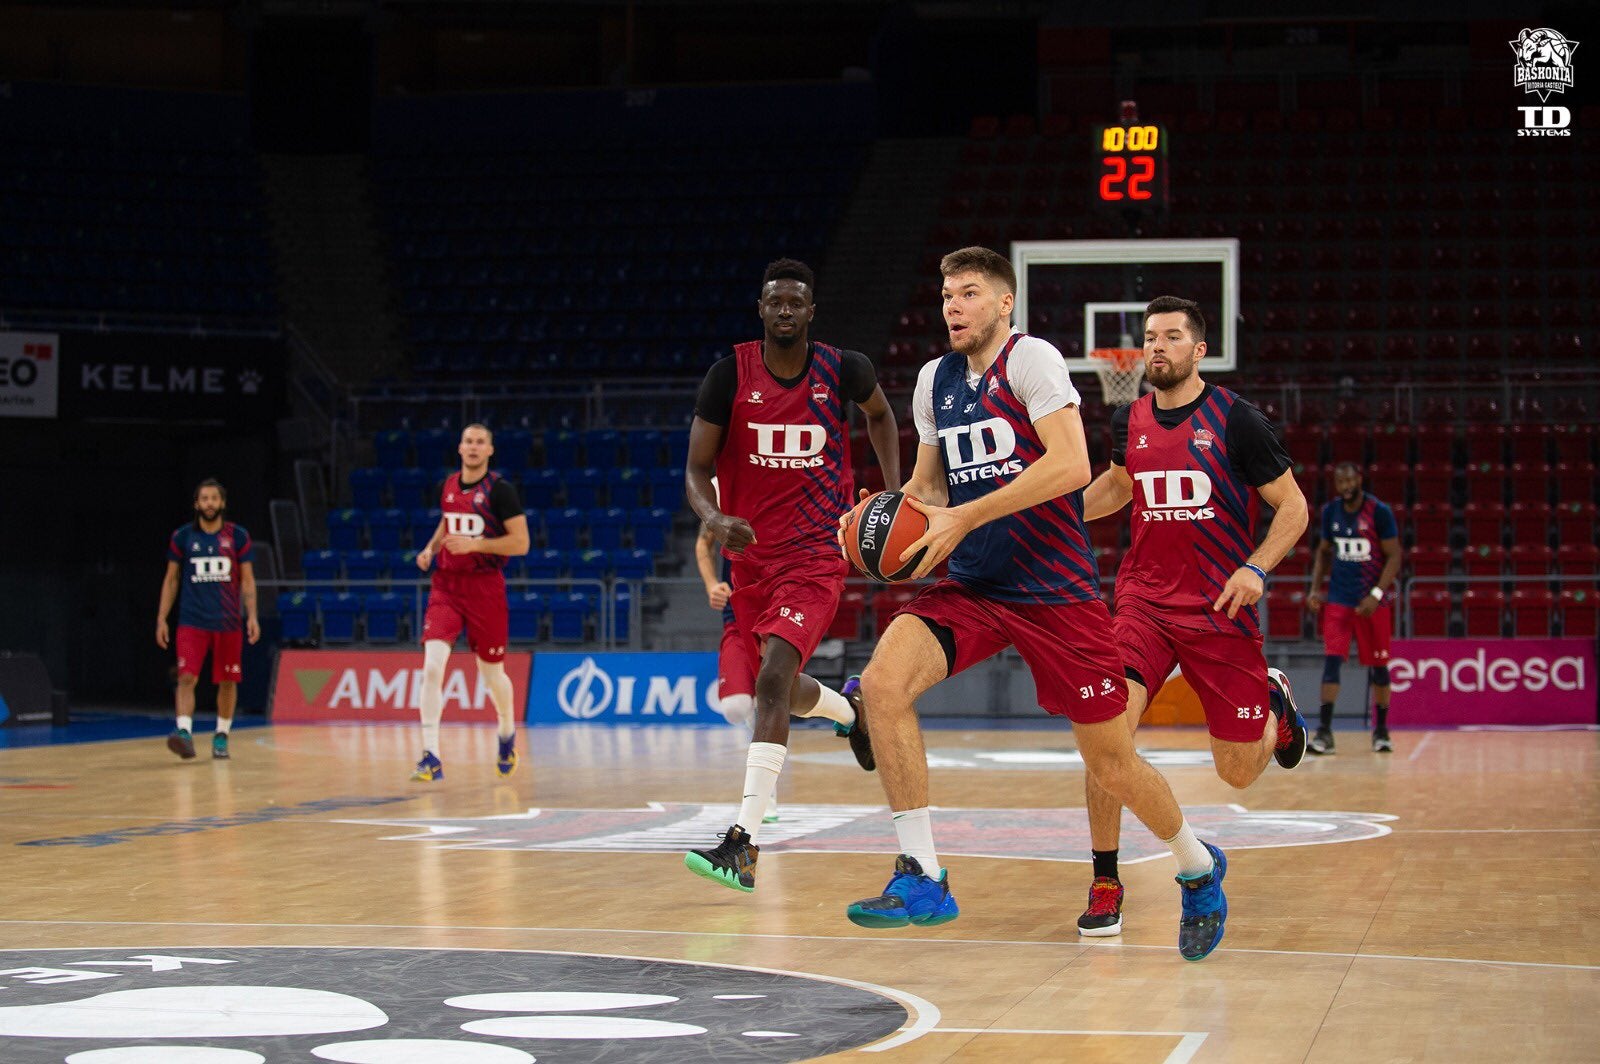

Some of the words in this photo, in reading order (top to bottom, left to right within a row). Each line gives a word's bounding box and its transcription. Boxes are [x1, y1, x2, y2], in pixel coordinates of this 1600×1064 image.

[1100, 156, 1155, 200] 22
[80, 363, 225, 394] KELME
[747, 421, 827, 457] TD
[938, 417, 1016, 470] TD
[749, 454, 824, 469] SYSTEMS
[1134, 470, 1212, 508] TD
[445, 512, 485, 536] TD
[1333, 537, 1371, 556] TD
[190, 556, 232, 577] TD
[780, 606, 791, 617] 19
[1387, 648, 1585, 692] endesa
[1080, 685, 1095, 699] 31
[1237, 707, 1250, 719] 25
